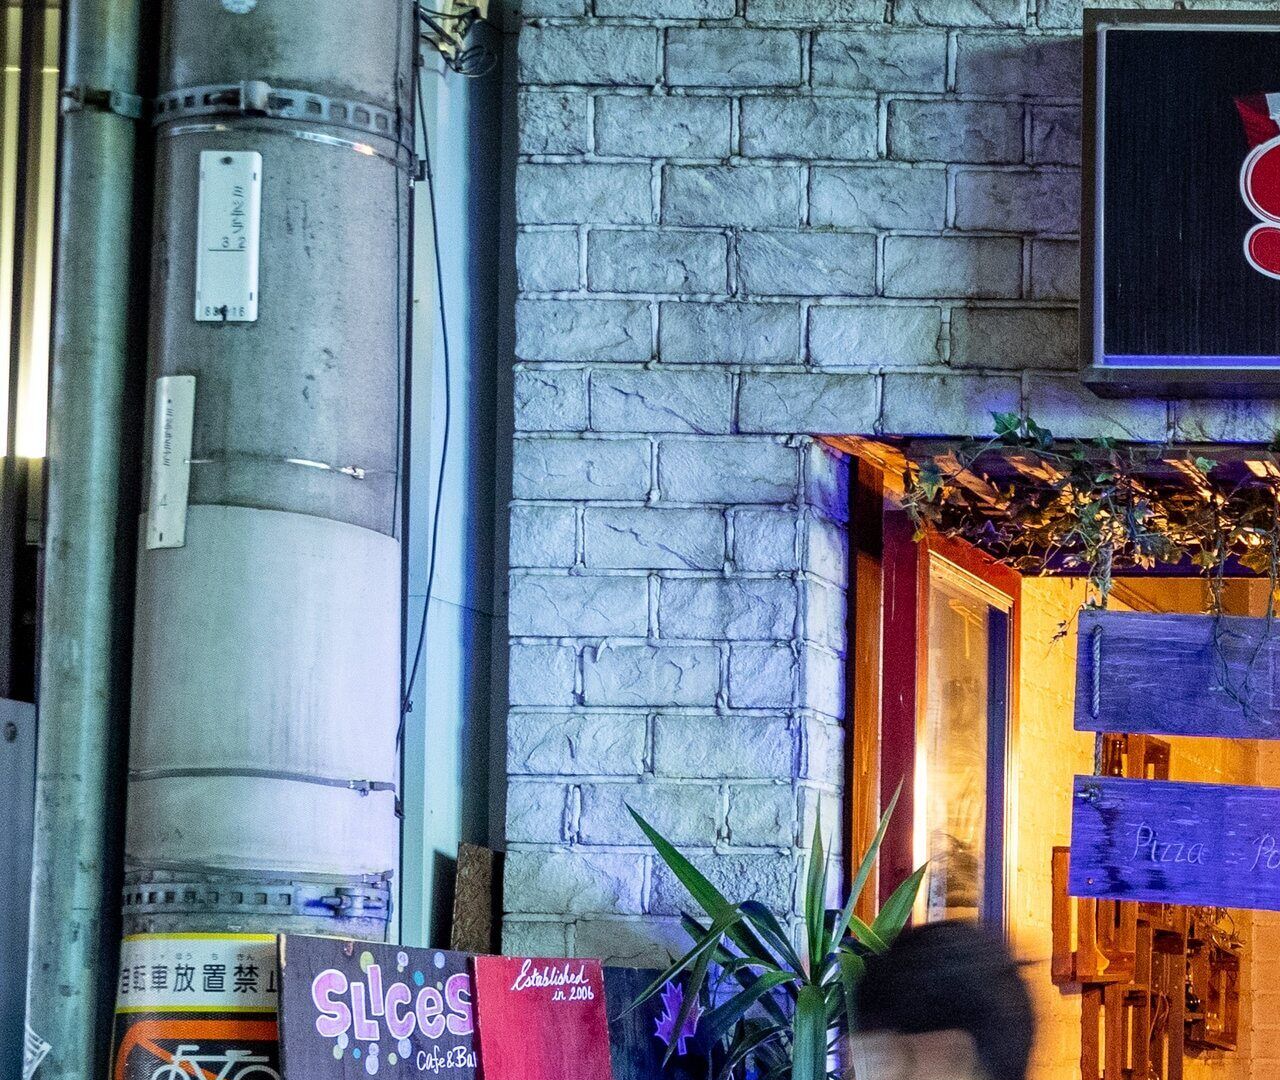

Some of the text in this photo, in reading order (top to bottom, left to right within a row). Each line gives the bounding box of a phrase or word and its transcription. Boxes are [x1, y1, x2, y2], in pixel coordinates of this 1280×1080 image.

[510, 959, 589, 991] Established
[552, 987, 595, 1001] in 2006
